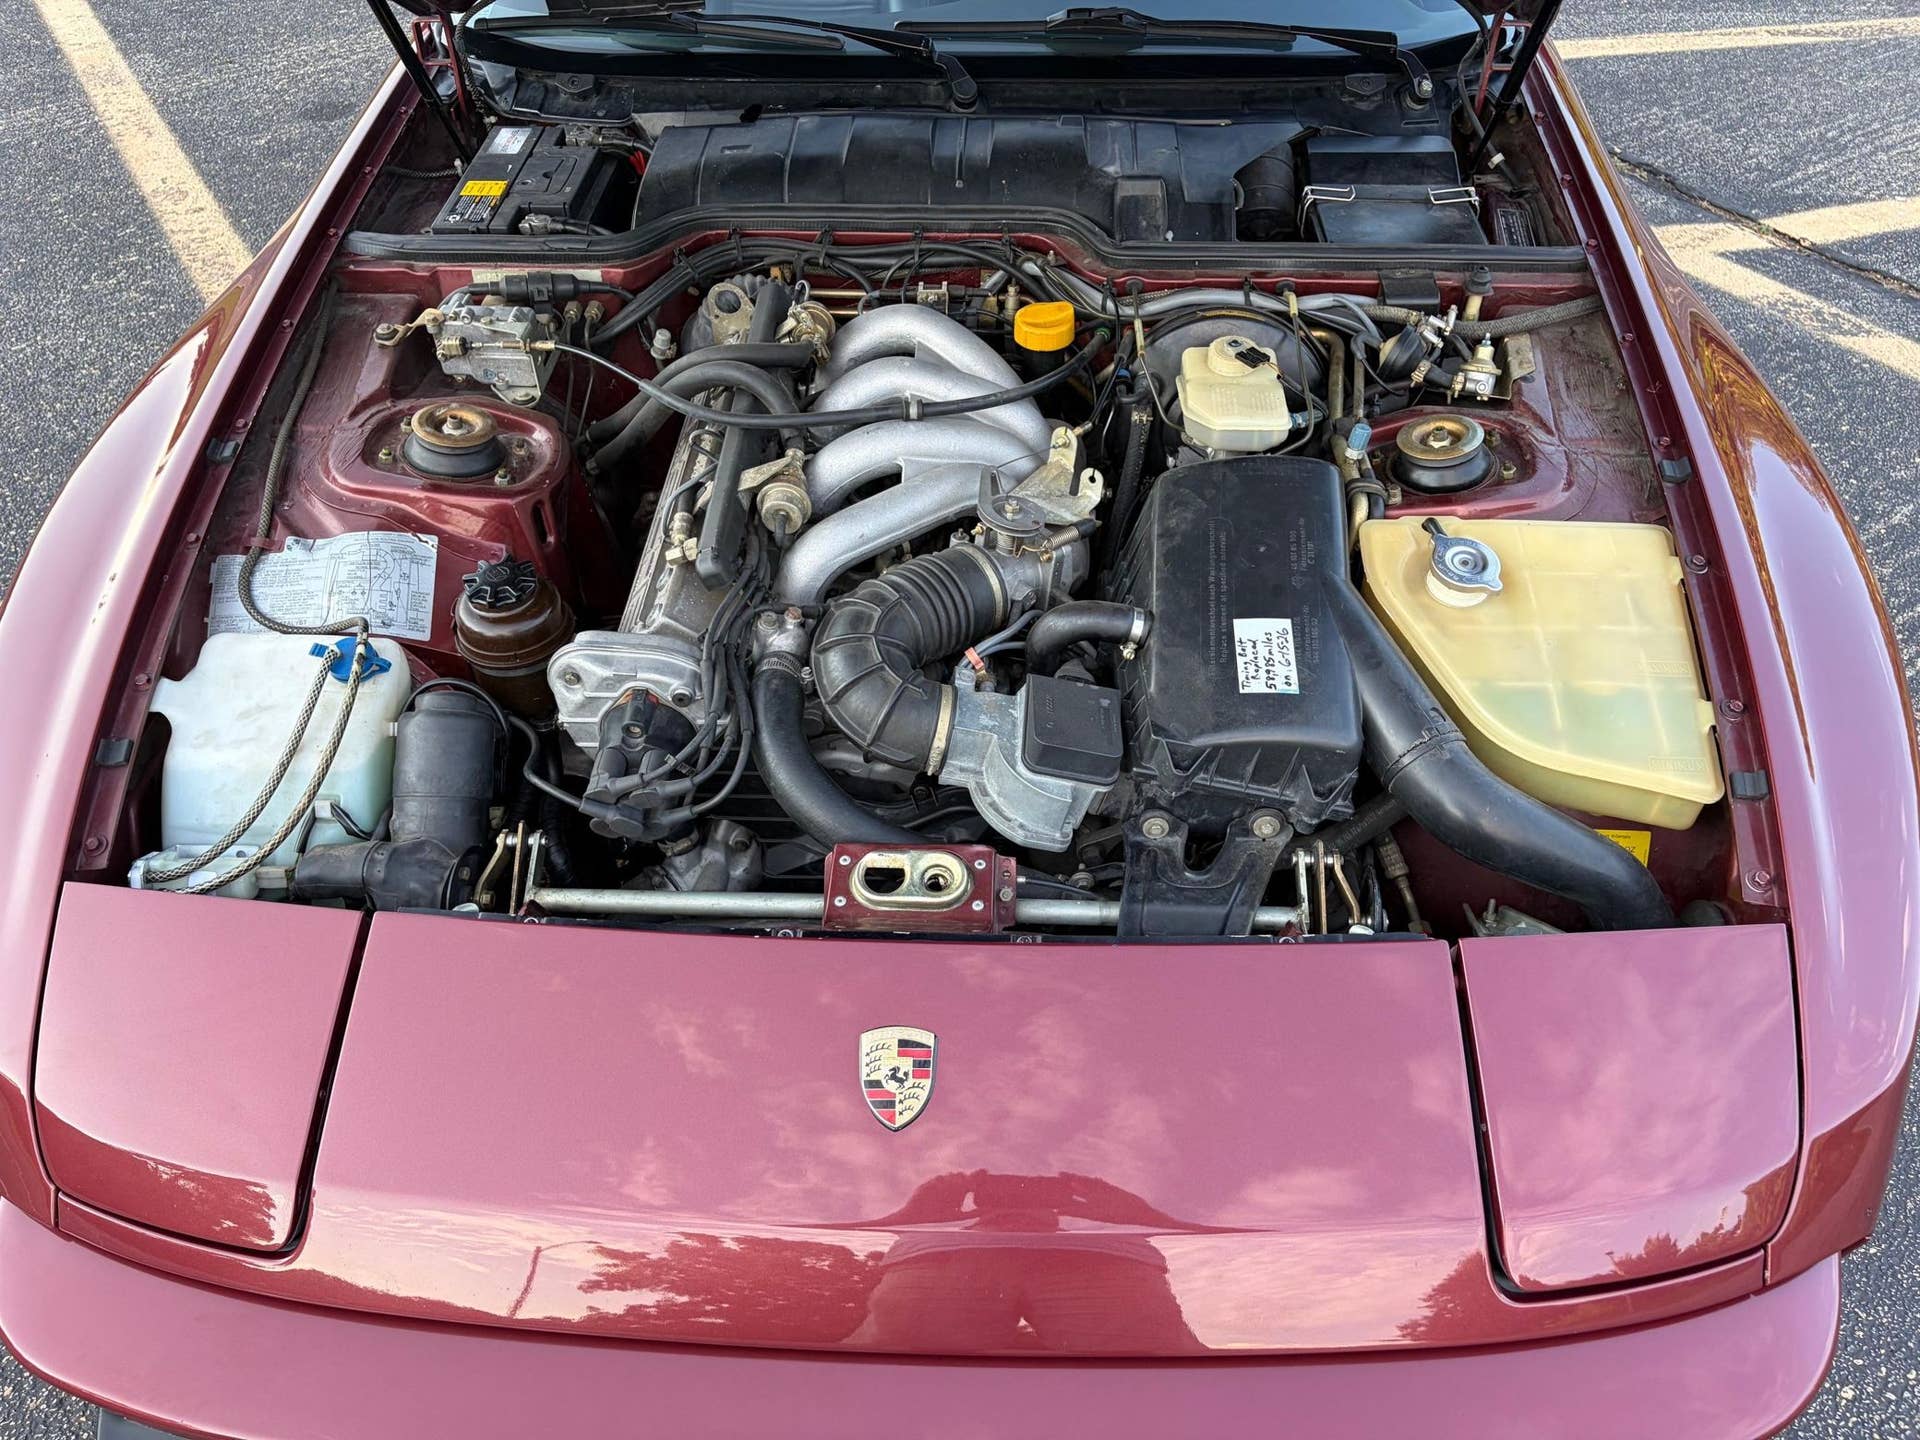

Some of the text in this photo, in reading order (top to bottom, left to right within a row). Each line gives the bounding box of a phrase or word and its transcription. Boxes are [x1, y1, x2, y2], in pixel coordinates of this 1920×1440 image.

[1236, 637, 1253, 690] Timing Belt
[1247, 639, 1262, 680] Replaced
[1276, 627, 1291, 667] 6-15-26
